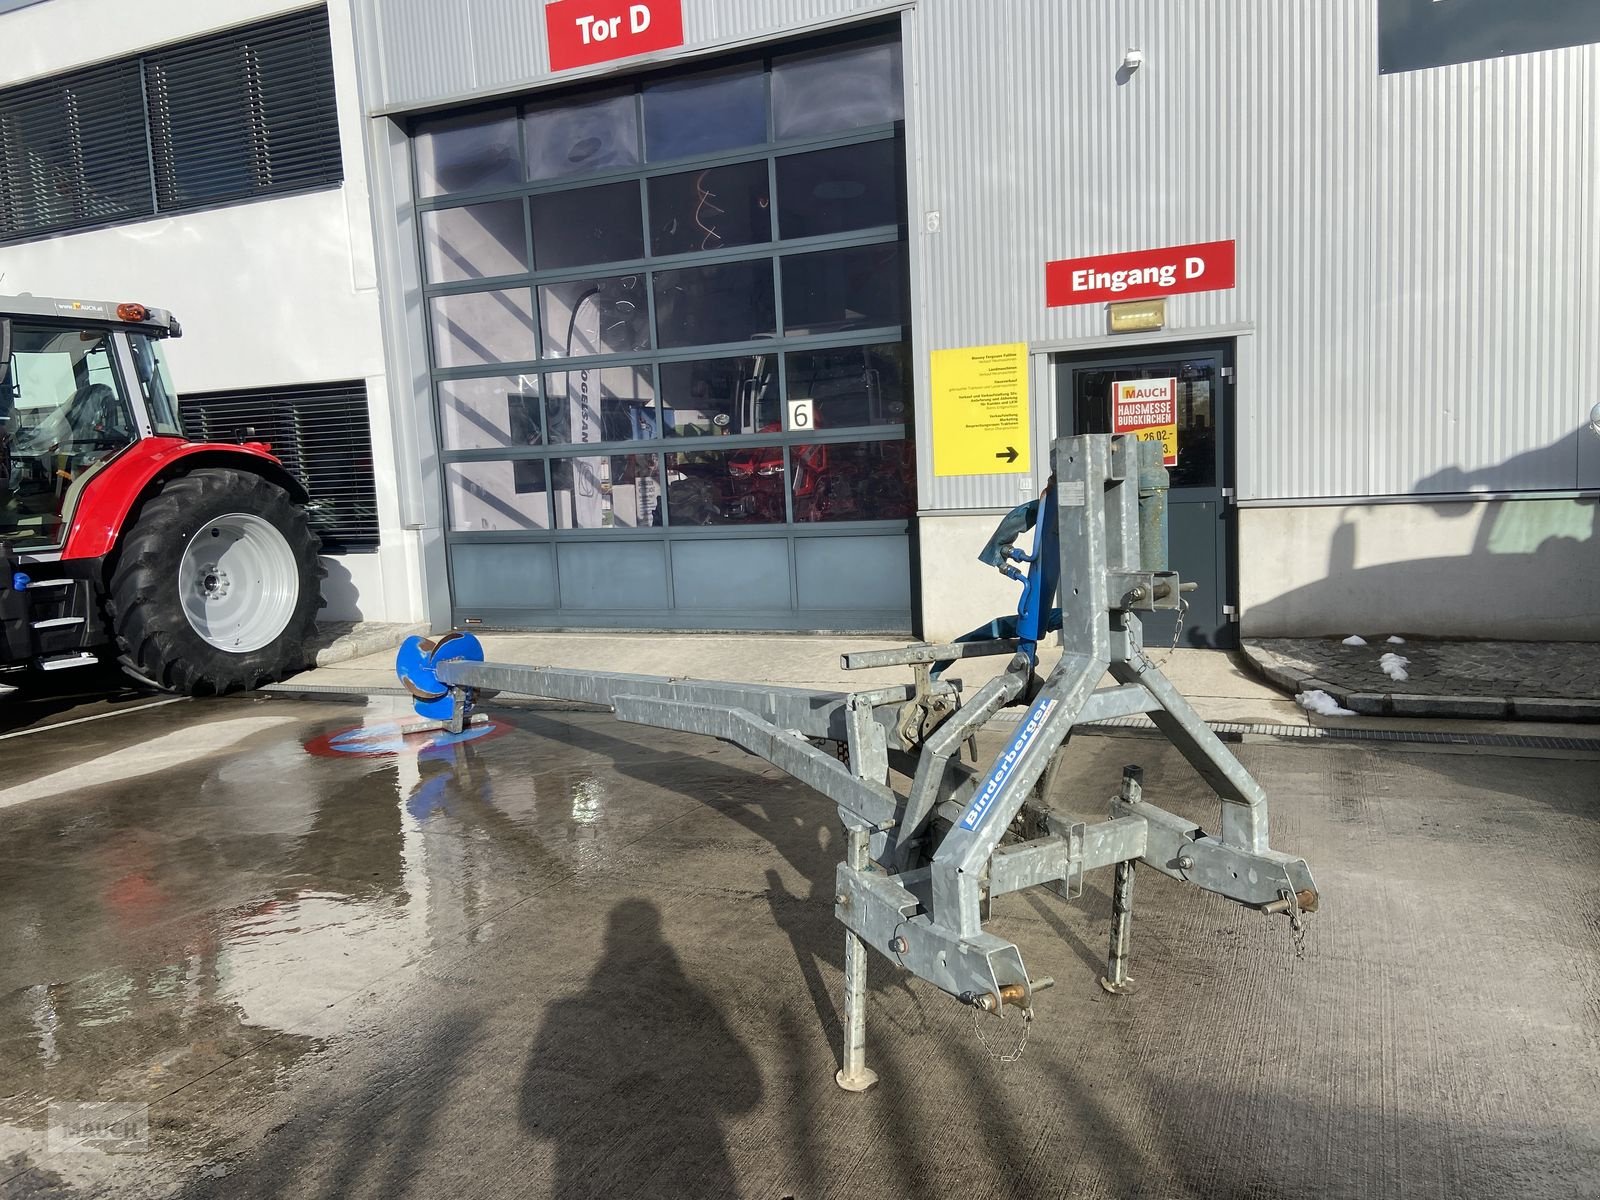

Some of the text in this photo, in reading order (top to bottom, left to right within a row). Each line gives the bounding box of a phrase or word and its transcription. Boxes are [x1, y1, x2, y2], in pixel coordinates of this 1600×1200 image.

[575, 4, 651, 45] Tor D
[1072, 256, 1205, 292] Eingang D
[580, 369, 589, 443] OGELSAN
[1125, 387, 1167, 399] MAUCH
[794, 403, 808, 427] 6
[1118, 402, 1171, 416] HAUSMESSE
[1118, 414, 1171, 426] BURGKIRCHEN
[965, 700, 1047, 826] Binderberger
